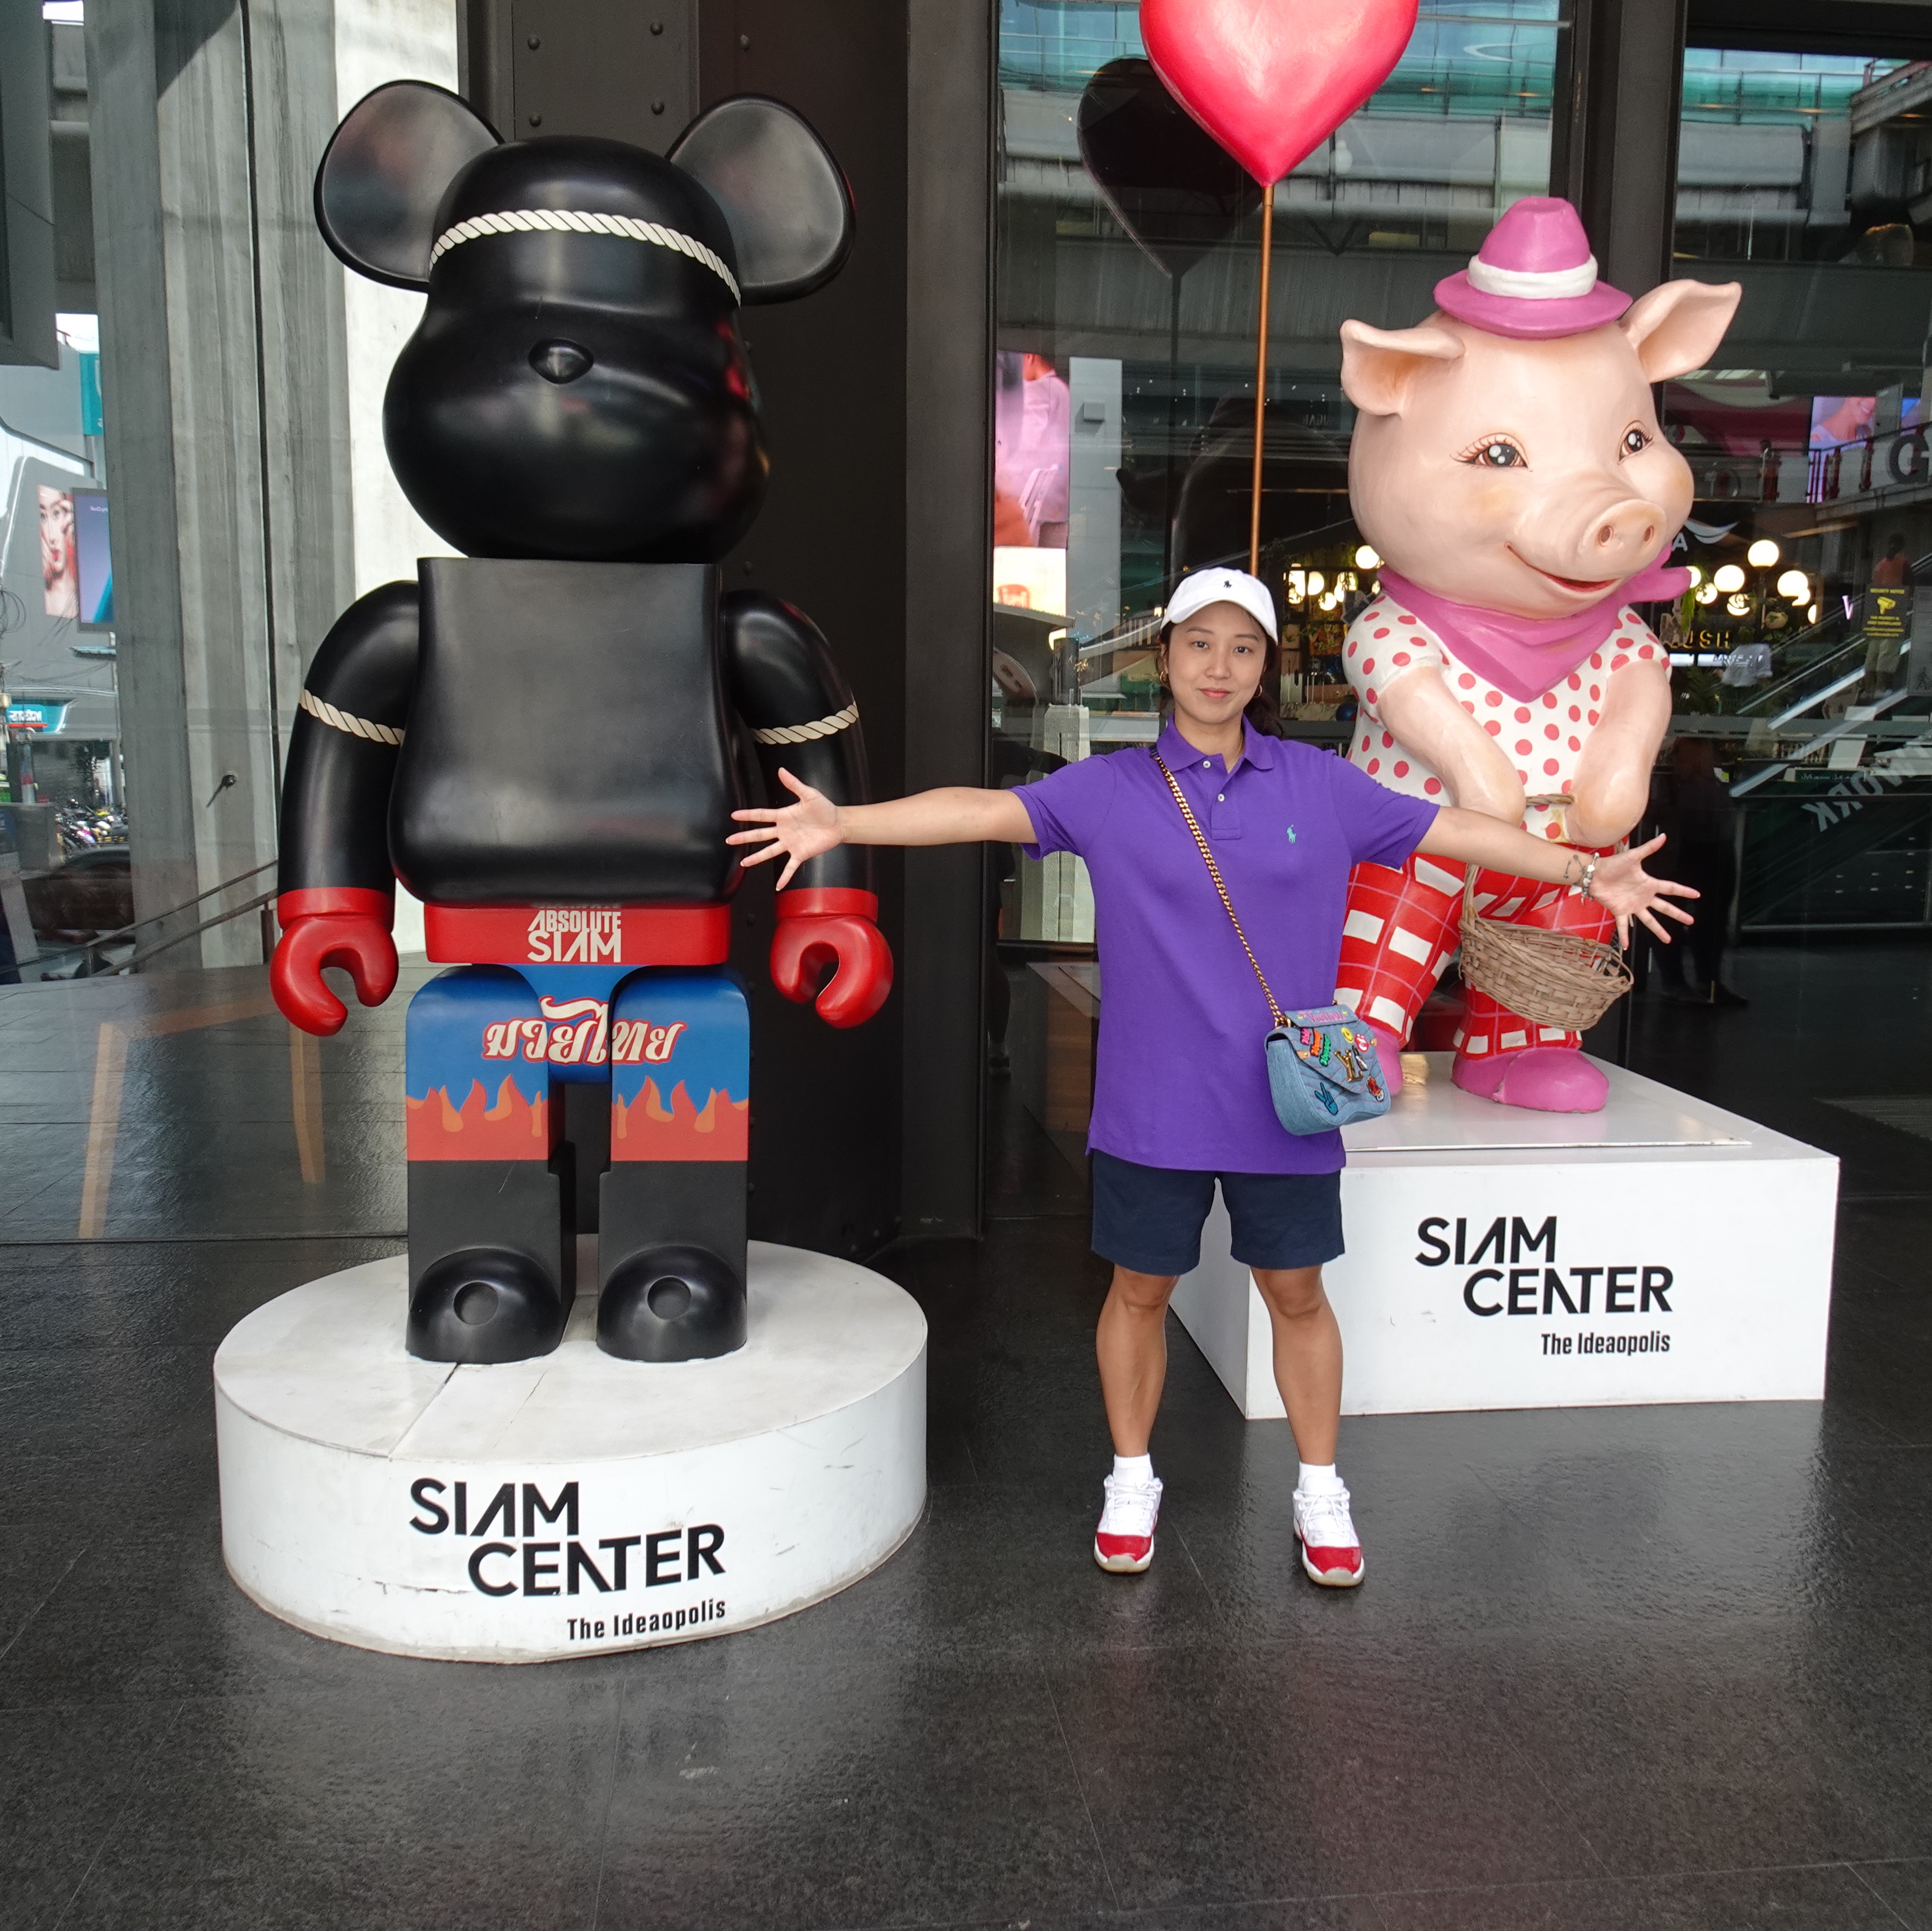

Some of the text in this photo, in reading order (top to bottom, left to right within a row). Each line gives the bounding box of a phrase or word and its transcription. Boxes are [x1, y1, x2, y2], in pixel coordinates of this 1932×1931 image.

[527, 910, 621, 933] ABSOLUTE
[527, 930, 621, 962] SIAM
[1414, 1216, 1557, 1266] SIAM
[1463, 1266, 1673, 1316] CENTER
[1541, 1330, 1671, 1356] The Ideaopolis
[409, 1478, 579, 1537] SIAM
[468, 1524, 726, 1597] CENTER
[567, 1599, 726, 1641] The Ideaopolis
